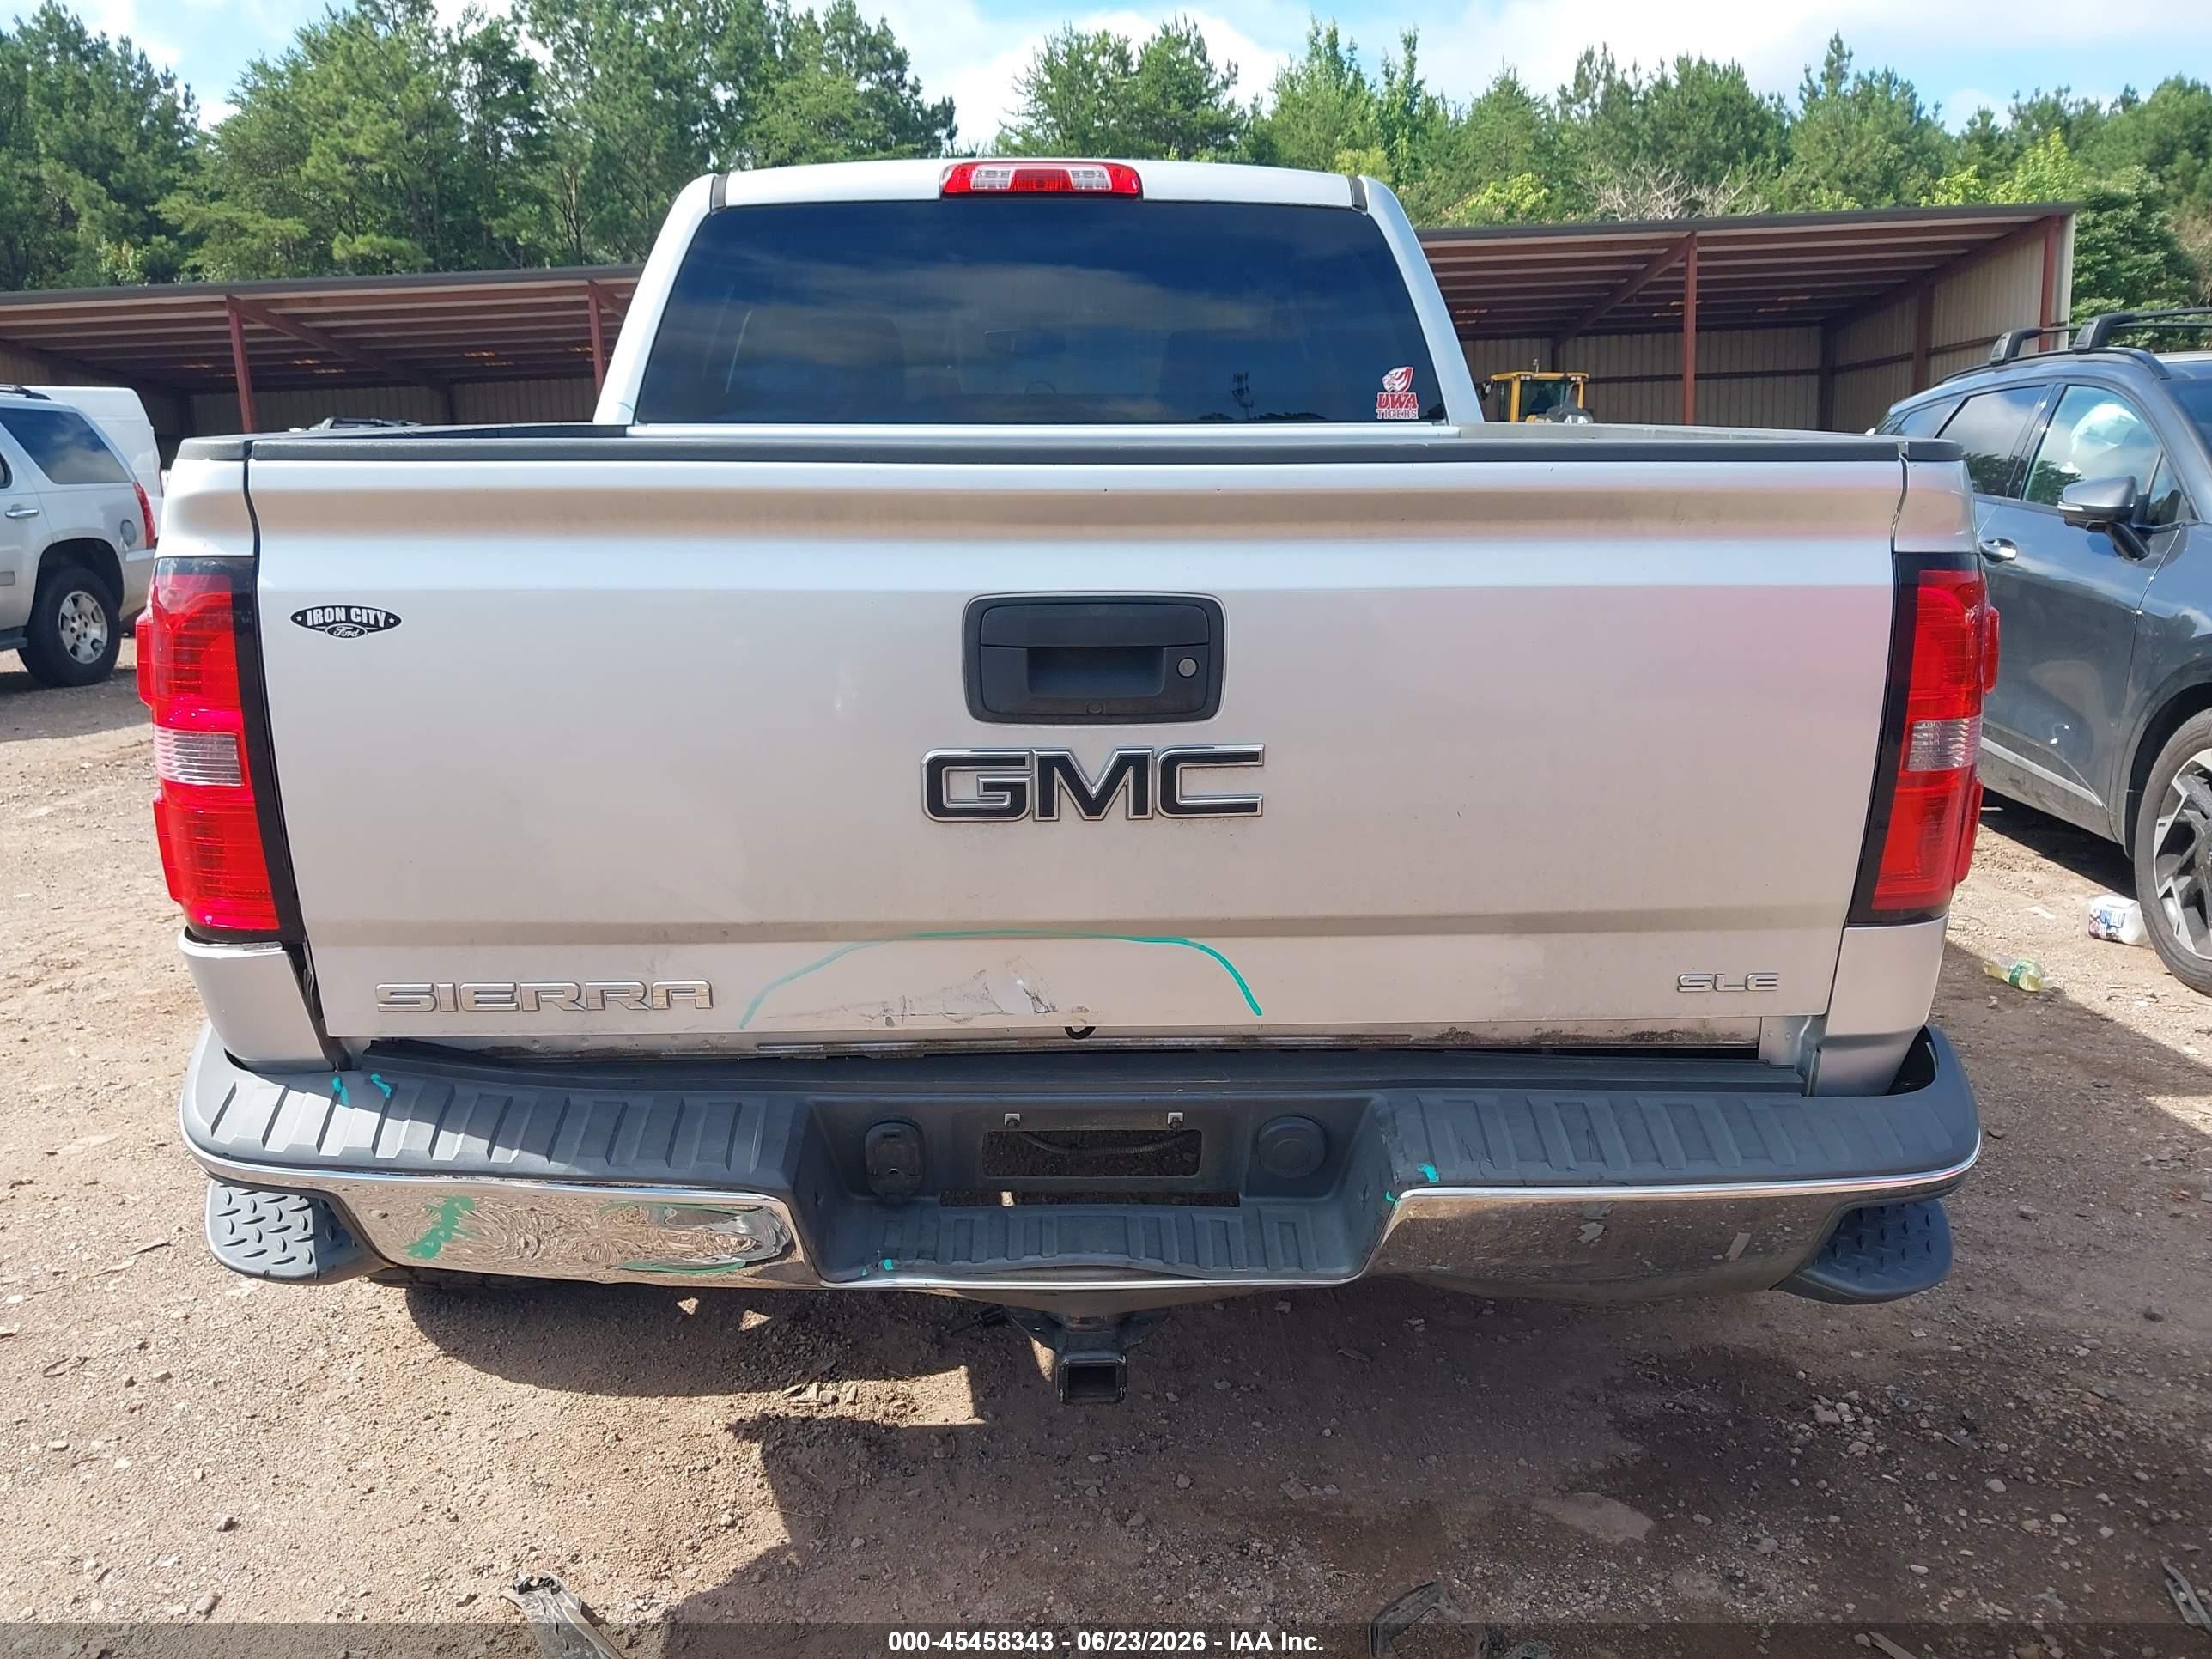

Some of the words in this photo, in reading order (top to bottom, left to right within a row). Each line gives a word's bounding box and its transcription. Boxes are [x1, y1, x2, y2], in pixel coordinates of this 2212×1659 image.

[1377, 393, 1417, 409] UWA
[1376, 410, 1417, 418] TIGERS
[307, 606, 345, 626] IRON
[350, 607, 386, 628] CITY
[921, 744, 1264, 822] GMC
[1677, 973, 1779, 992] SLE
[375, 981, 714, 1012] SIERRA
